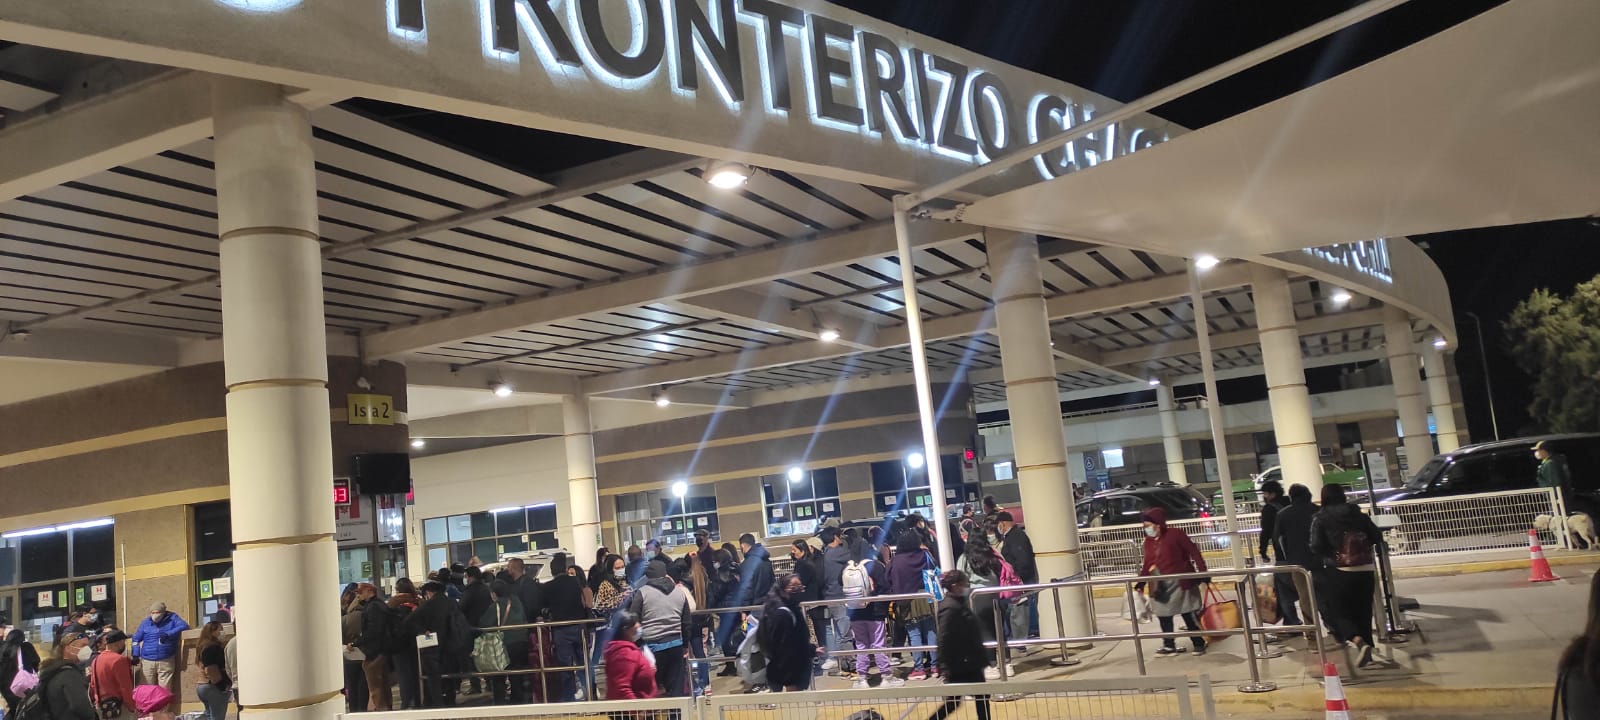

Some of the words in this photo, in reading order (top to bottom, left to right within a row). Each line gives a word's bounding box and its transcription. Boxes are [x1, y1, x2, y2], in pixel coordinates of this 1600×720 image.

[354, 403, 379, 418] Isa
[381, 402, 390, 419] 2
[334, 487, 347, 503] 3
